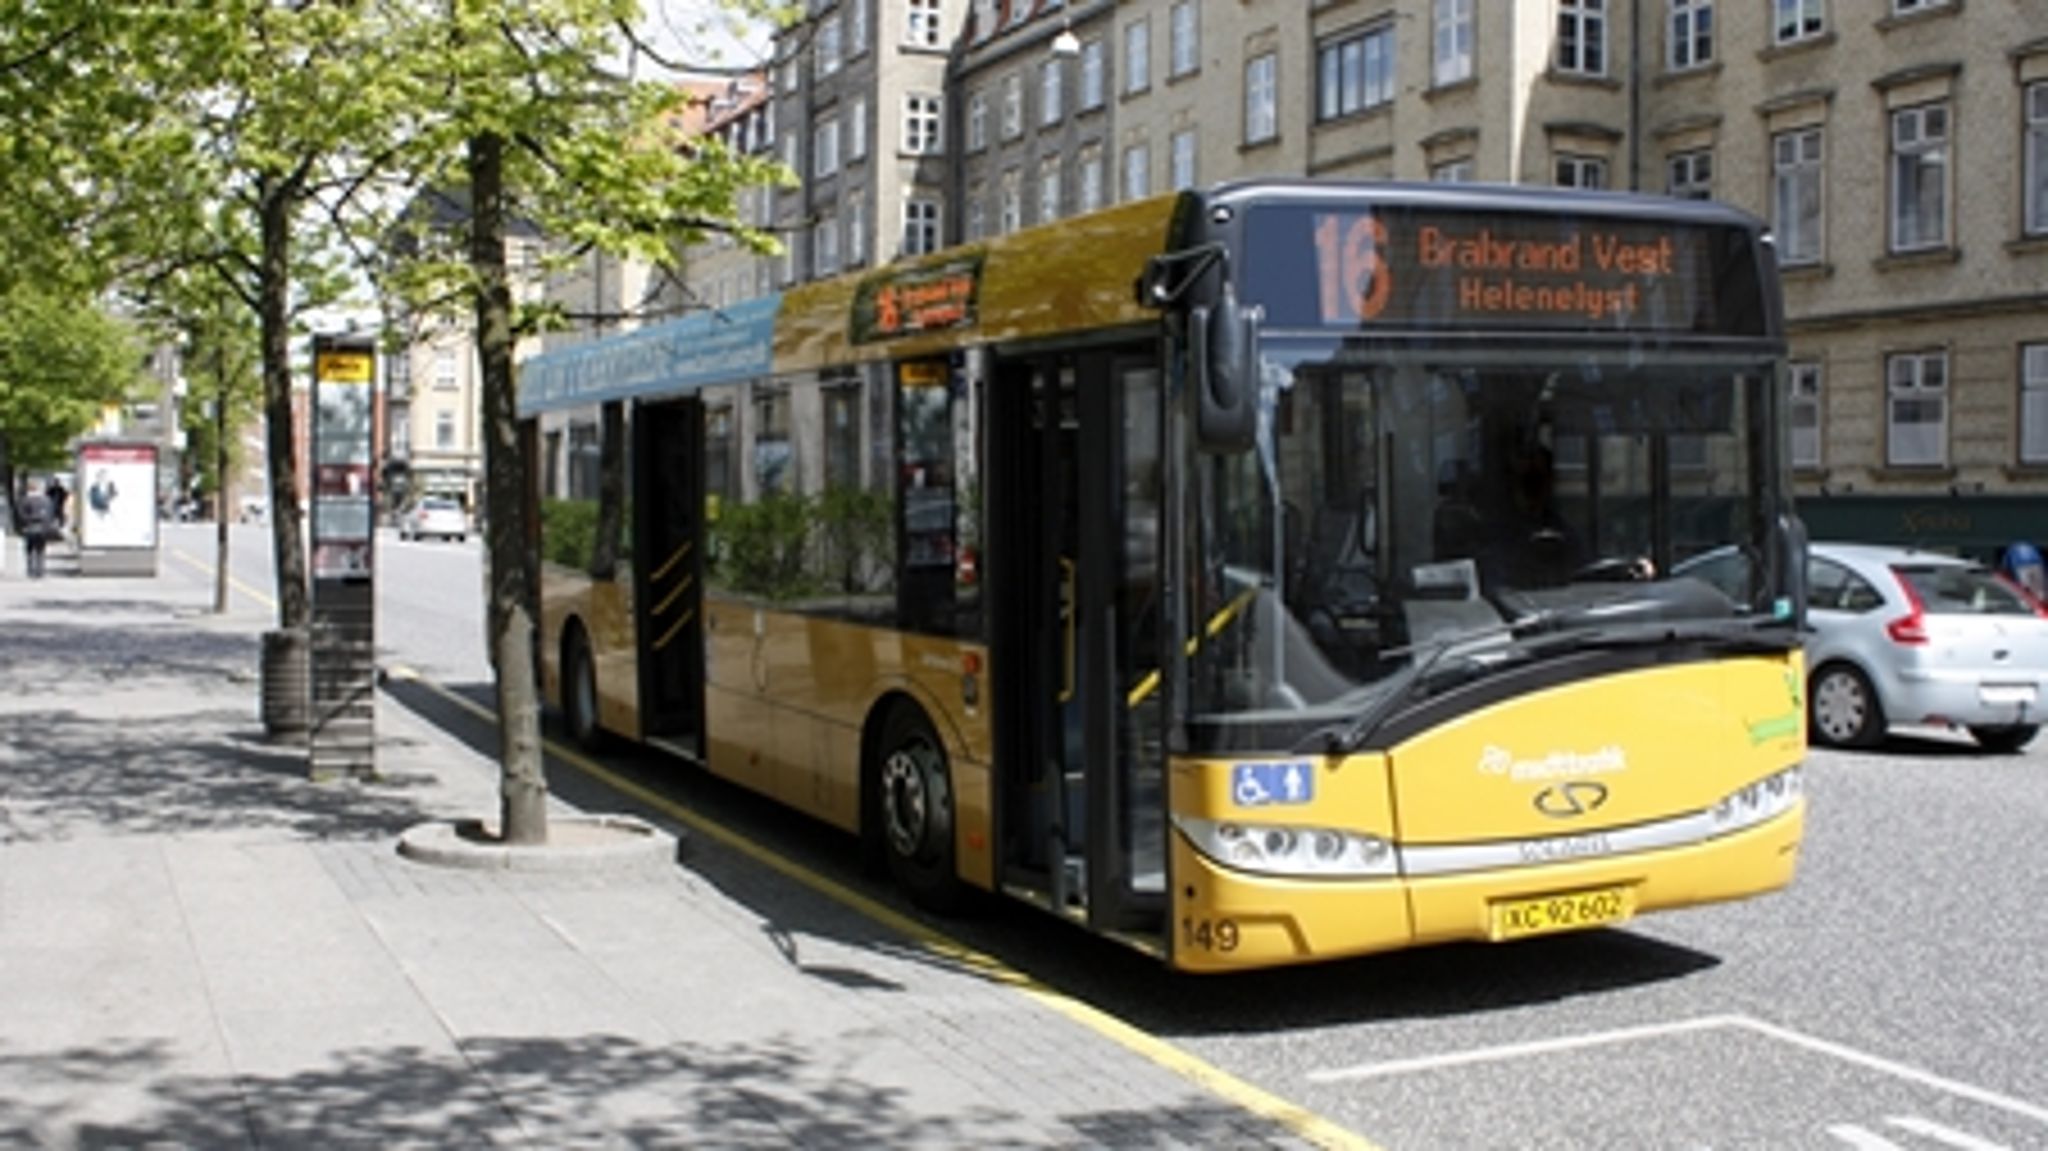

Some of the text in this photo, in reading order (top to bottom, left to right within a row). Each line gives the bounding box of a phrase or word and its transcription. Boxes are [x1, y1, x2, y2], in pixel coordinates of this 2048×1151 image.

[1315, 214, 1391, 320] 16
[1418, 226, 1673, 275] Brabrand Vest
[1460, 277, 1637, 319] Helenelyst
[1183, 917, 1239, 952] 149
